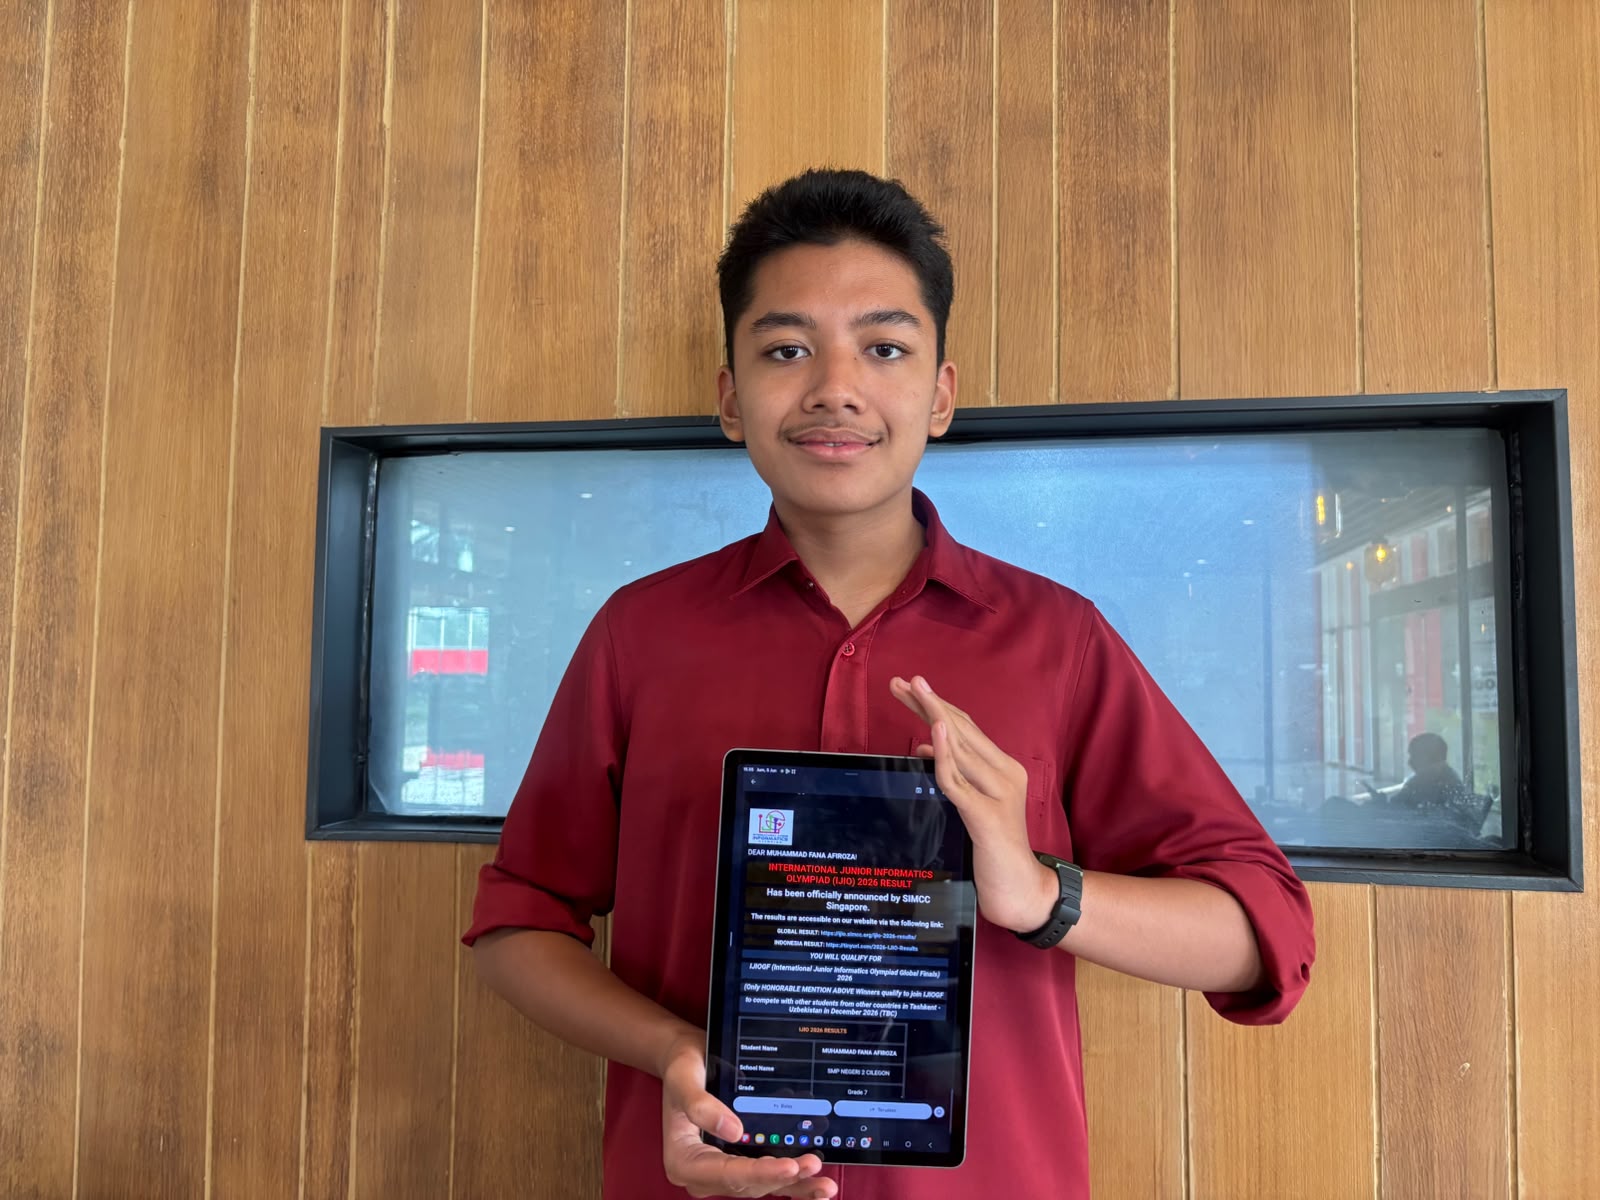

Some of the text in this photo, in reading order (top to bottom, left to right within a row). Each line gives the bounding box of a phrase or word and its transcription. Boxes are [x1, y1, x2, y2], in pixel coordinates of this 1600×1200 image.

[827, 852, 857, 860] AFIROZA!
[768, 863, 933, 878] INTERNATIONAL JUNIOR INFORMATICS
[786, 875, 912, 888] OLYMPIAD (IJIO) 2026 RESULT
[767, 888, 931, 904] Has been officially announced by SIMCC
[826, 902, 870, 912] Singapore.
[799, 915, 831, 923] accessible
[901, 920, 929, 928] following
[841, 954, 868, 962] QUALIFY
[771, 964, 812, 972] (International
[834, 967, 868, 975] Informatics
[870, 968, 898, 977] Olympiad
[920, 970, 940, 978] Finals)
[761, 984, 800, 992] HONORABLE
[882, 989, 902, 998] qualify
